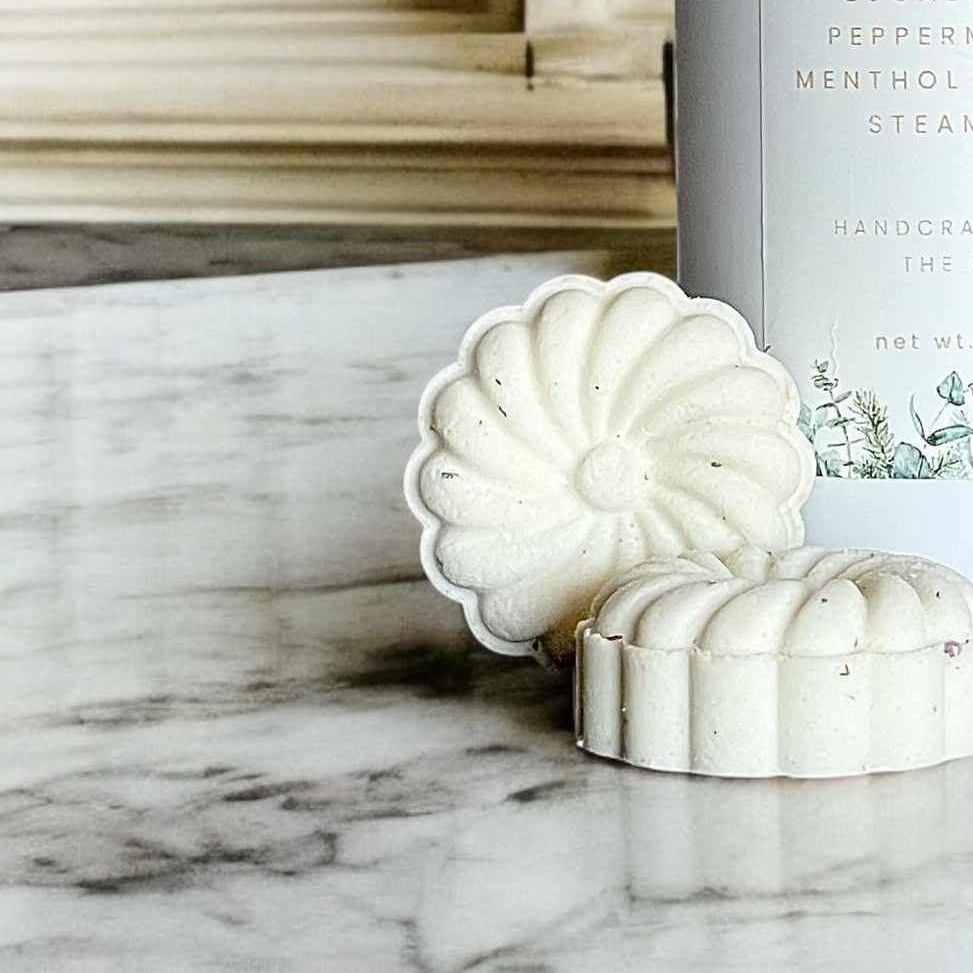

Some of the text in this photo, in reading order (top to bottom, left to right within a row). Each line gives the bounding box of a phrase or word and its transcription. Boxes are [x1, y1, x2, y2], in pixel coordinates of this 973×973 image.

[796, 69, 958, 89] MENTHOL
[903, 256, 952, 273] THE
[876, 333, 919, 350] net
[934, 333, 973, 349] wt.
